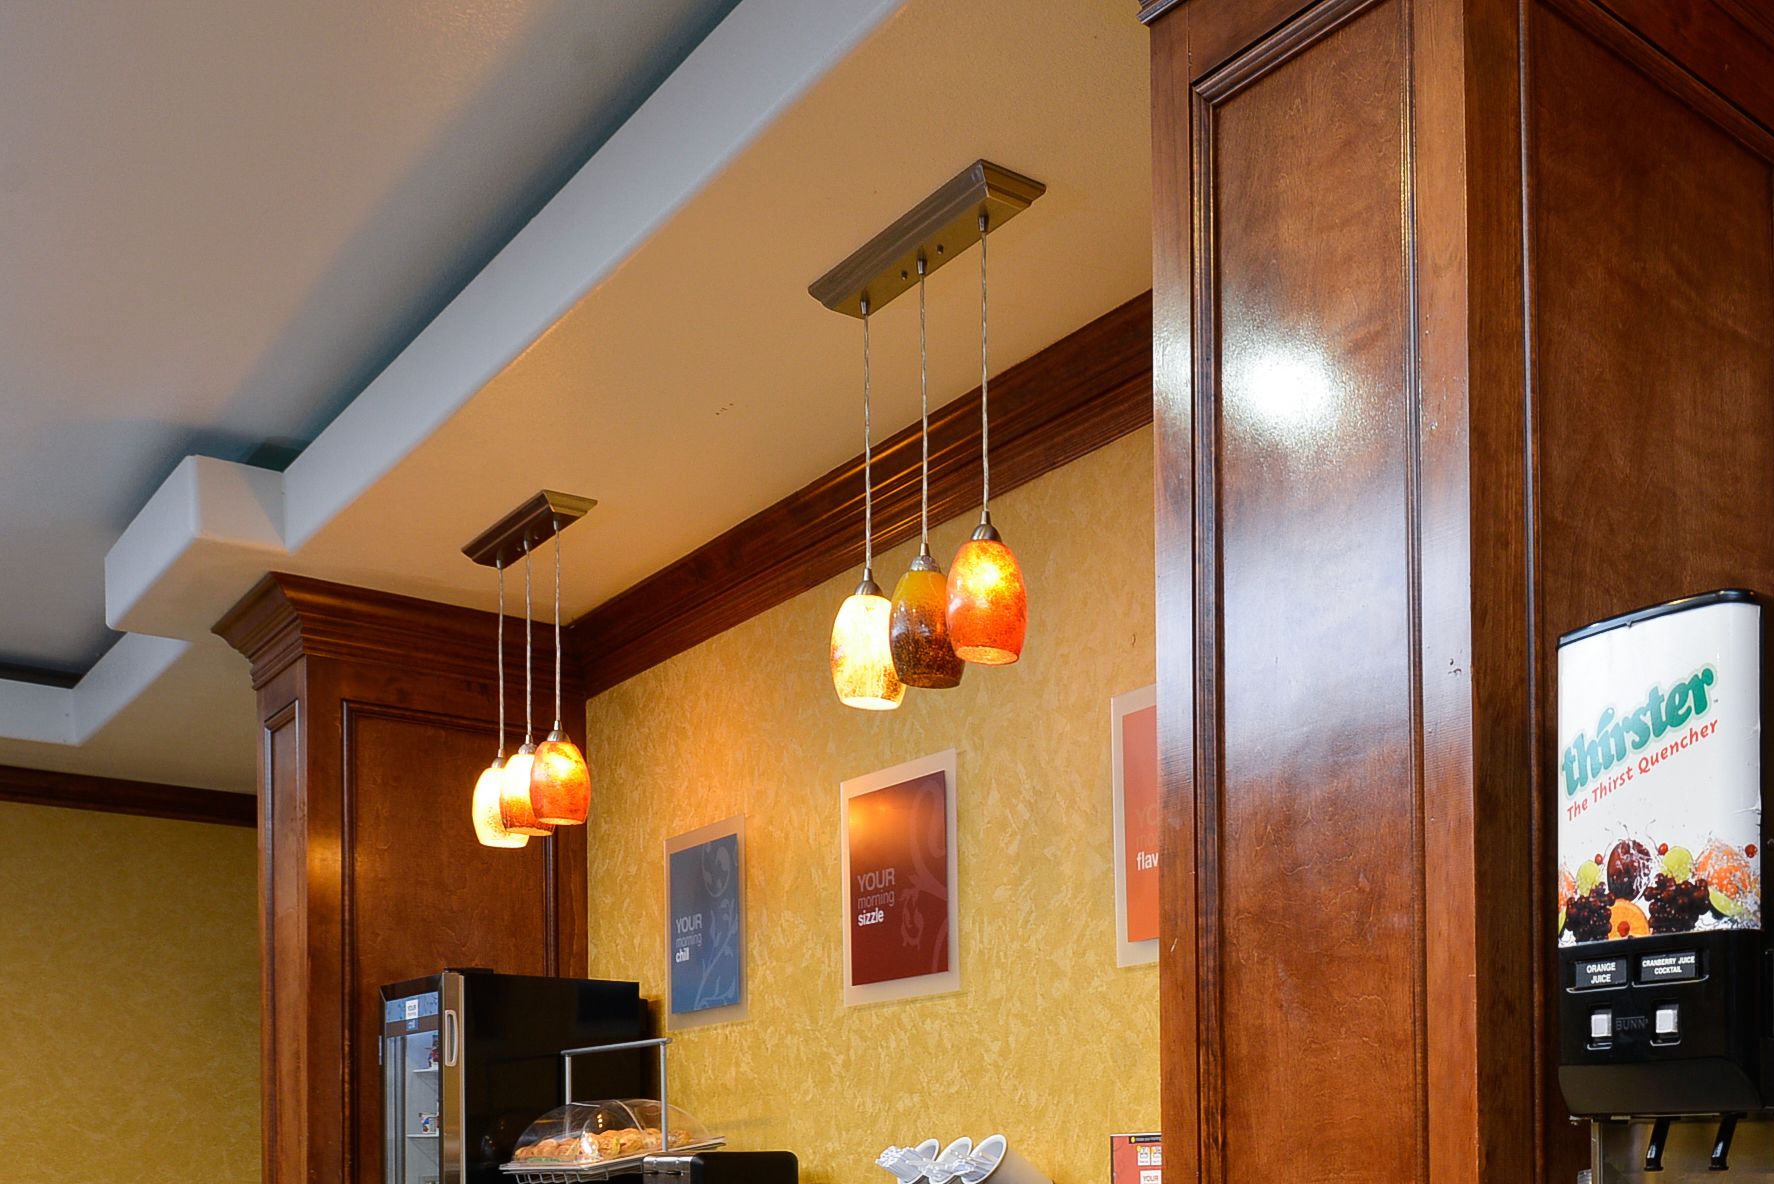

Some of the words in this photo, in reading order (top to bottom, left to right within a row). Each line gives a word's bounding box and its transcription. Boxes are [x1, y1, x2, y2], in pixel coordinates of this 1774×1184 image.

[1562, 668, 1714, 796] thirster
[1567, 798, 1588, 821] The
[1592, 766, 1634, 803] Thirst
[1638, 719, 1718, 774] Quencher
[1137, 851, 1159, 871] flav
[857, 867, 895, 892] YOUR
[857, 889, 895, 910] morning
[675, 913, 702, 934] YOUR
[858, 907, 884, 927] sizzle
[675, 947, 690, 963] chill
[1642, 958, 1676, 968] CRANBERRY
[1677, 955, 1695, 965] JUICE
[1586, 962, 1616, 974] ORANGE
[1654, 965, 1682, 975] COCKTAIL
[1590, 974, 1611, 984] JUICE
